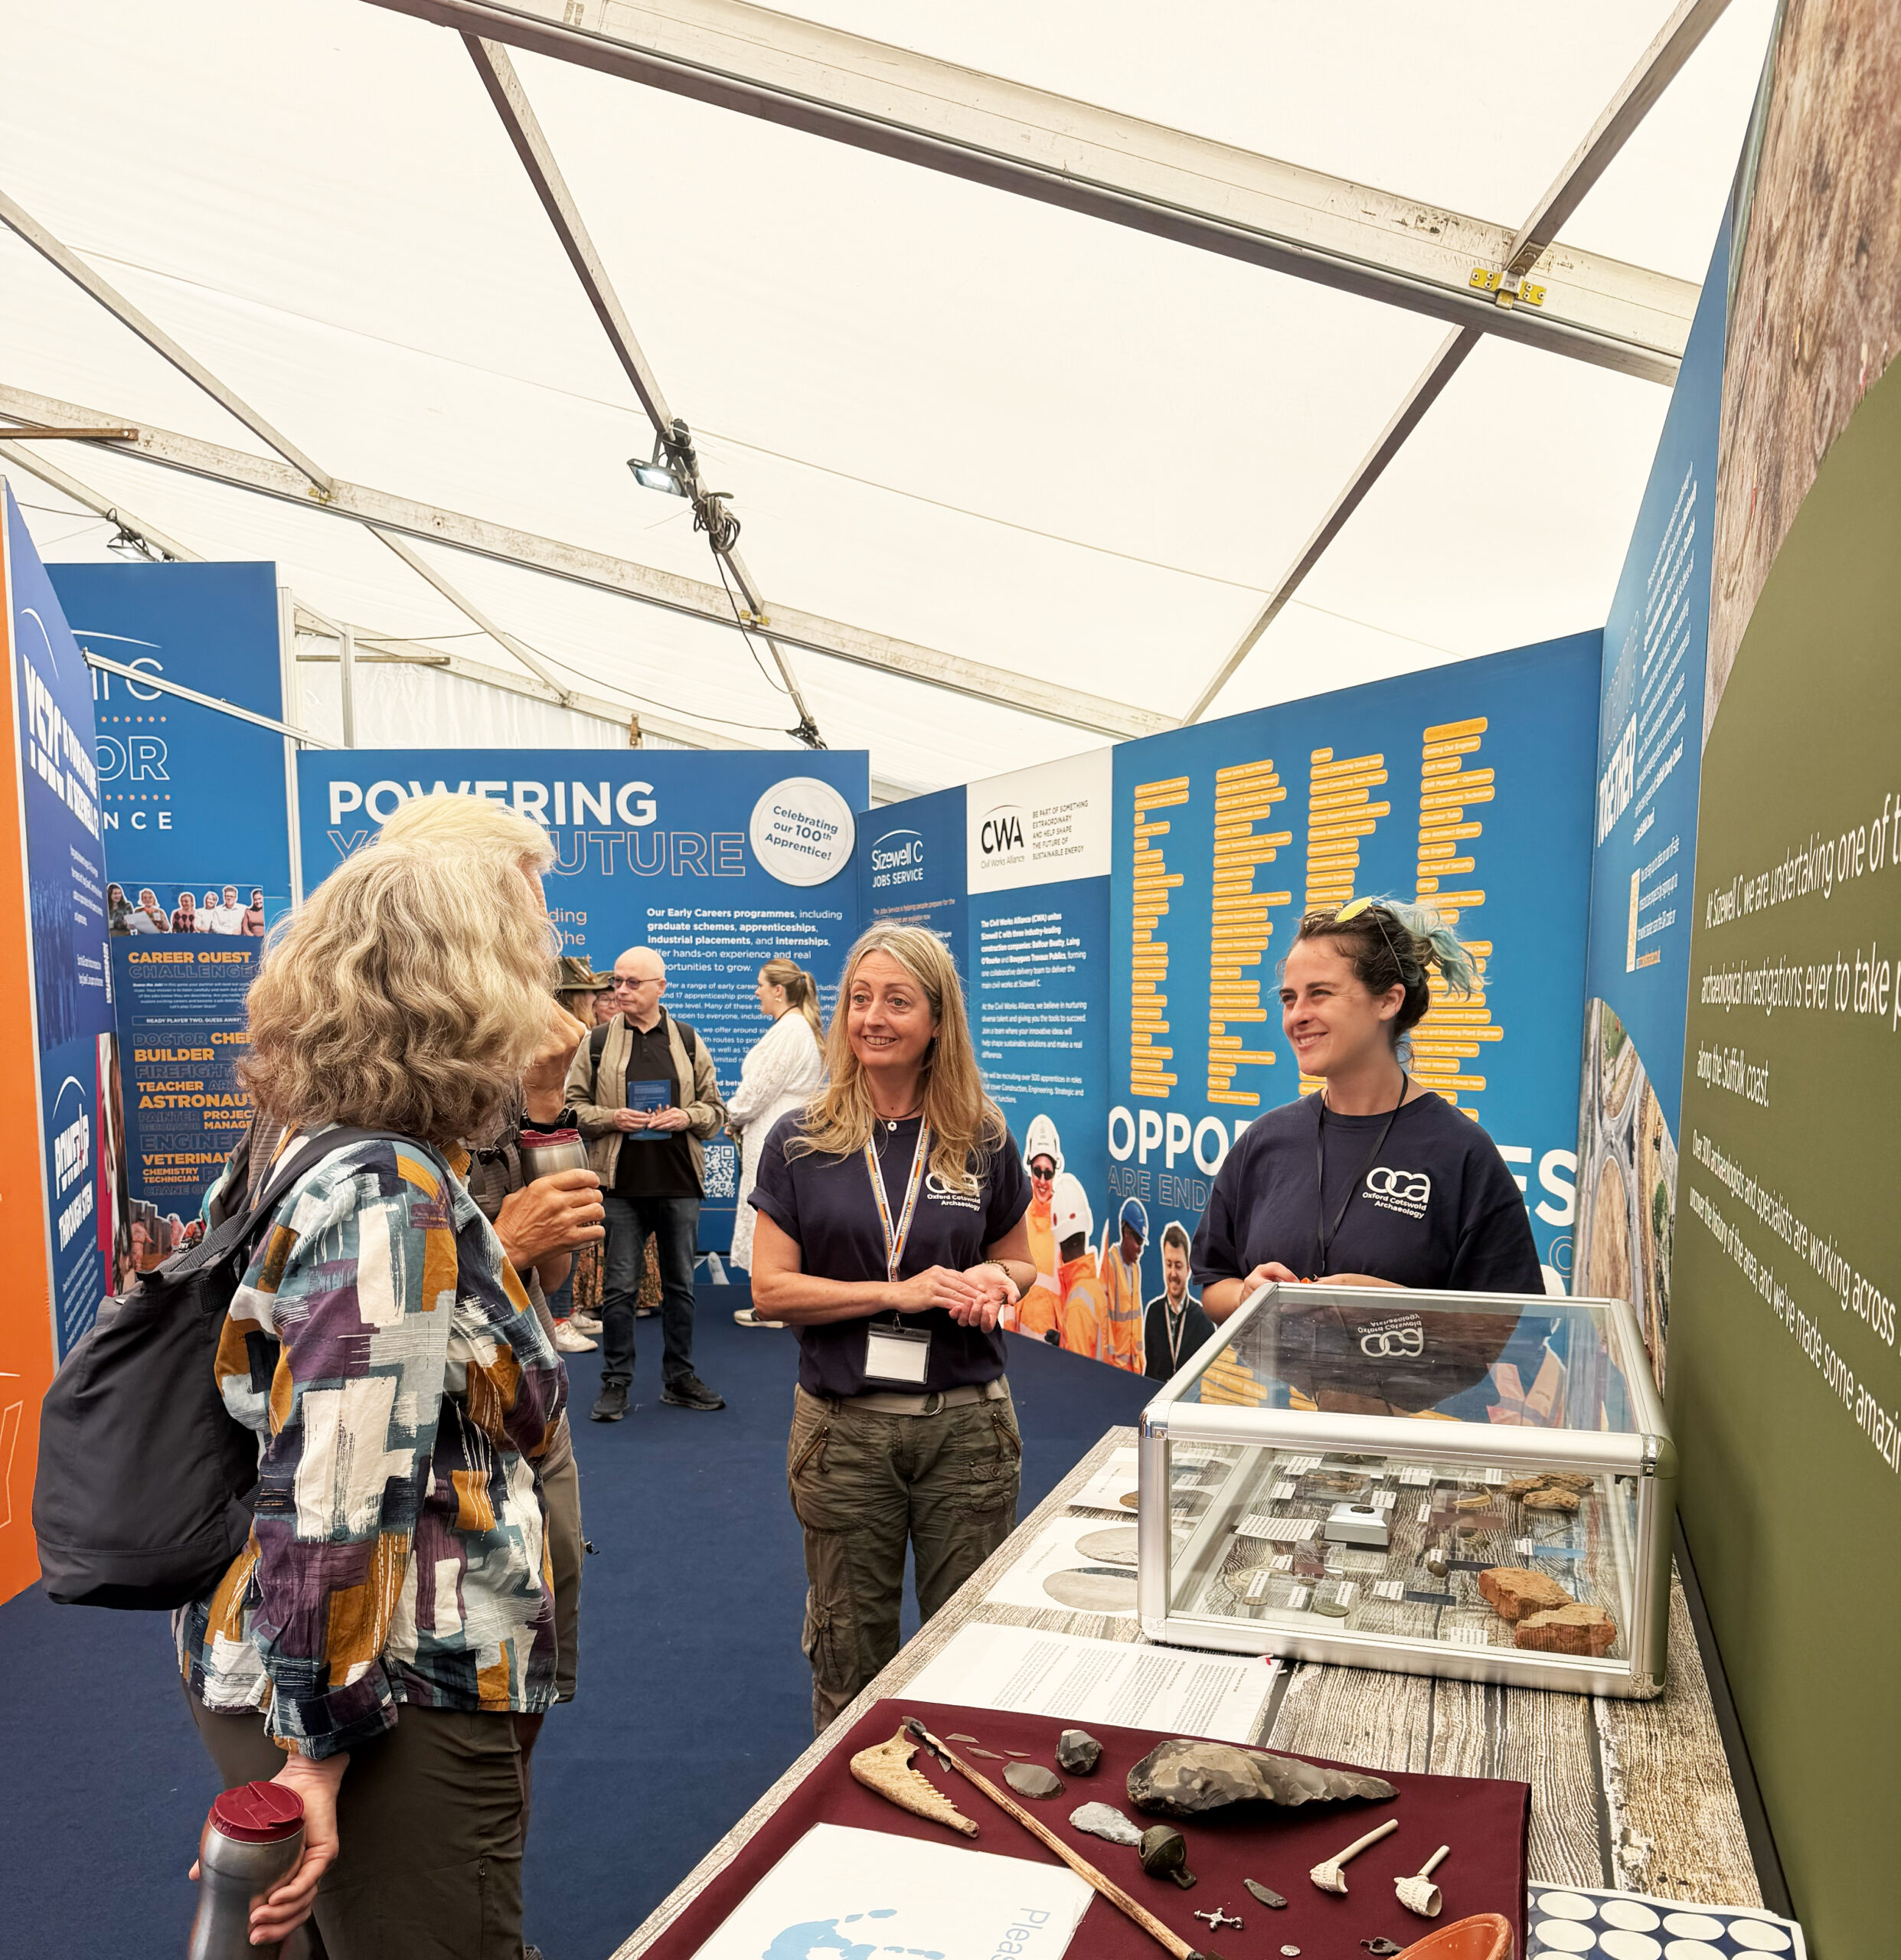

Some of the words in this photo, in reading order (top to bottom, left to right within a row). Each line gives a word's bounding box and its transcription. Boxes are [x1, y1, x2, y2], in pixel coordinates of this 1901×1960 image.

[1040, 808, 1051, 816] PART
[1052, 806, 1059, 815] OF
[1060, 800, 1089, 812] SOMETHING
[773, 805, 838, 835] Celebrating
[1033, 815, 1073, 829] EXTRAORDINARY
[773, 822, 794, 834] our
[795, 825, 832, 842] 100th
[982, 816, 1024, 854] CWA
[1044, 828, 1056, 838] HELP
[1057, 825, 1073, 835] SHAPE
[765, 833, 832, 861] Apprentice!
[1042, 838, 1060, 848] FUTURE
[1061, 836, 1069, 846] OF
[546, 831, 746, 877] UTURE
[871, 842, 912, 871] Sizewell
[913, 840, 923, 864] C
[1033, 848, 1063, 861] SUSTAINABLE
[1065, 845, 1084, 855] ENERGY
[991, 857, 1006, 867] Works
[1007, 854, 1025, 864] Alliance
[1705, 893, 1713, 929] At
[1712, 876, 1737, 927] Sizewell
[1736, 874, 1744, 918] C
[1744, 878, 1754, 915] we
[1755, 871, 1769, 911] are
[1770, 831, 1835, 906] undertaking
[1837, 825, 1866, 883] one
[1870, 792, 1891, 872] of
[872, 874, 890, 888] JOBS
[892, 867, 924, 885] SERVICE
[646, 908, 665, 918] Our
[668, 908, 692, 920] Early
[694, 909, 732, 919] Careers
[733, 909, 797, 921] programmes,
[799, 910, 843, 922] including
[647, 923, 691, 933] graduate
[693, 923, 737, 933] schemes,
[740, 923, 818, 934] apprenticeships,
[647, 935, 693, 945] industrial
[695, 936, 753, 946] placements,
[755, 936, 773, 946] and
[776, 936, 831, 948] internships,
[128, 952, 194, 964] CAREER
[198, 952, 252, 964] QUEST
[673, 949, 717, 959] hands-on
[720, 949, 772, 960] experience
[773, 950, 792, 959] and
[794, 950, 812, 959] real
[663, 962, 712, 973] portunities
[714, 963, 724, 972] to
[727, 964, 753, 974] grow.
[1701, 959, 1743, 1013] archaeological
[1743, 953, 1803, 1017] investigations
[1805, 964, 1833, 1010] ever
[1834, 950, 1850, 1012] to
[1854, 941, 1890, 1015] take
[741, 1013, 772, 1021] including
[133, 1033, 207, 1047] DOCTOR
[134, 1048, 215, 1063] BUILDER
[1697, 1040, 1712, 1089] along
[1712, 1044, 1722, 1086] the
[1722, 1047, 1746, 1096] Suffolk
[1746, 1060, 1769, 1109] coast.
[136, 1081, 204, 1093] TEACHER
[138, 1112, 201, 1123] PAINTER
[204, 1120, 252, 1130] MANAGE
[140, 1132, 243, 1152] ENGINEE
[142, 1152, 230, 1166] VETERINAR
[142, 1168, 198, 1176] CHEMISTRY
[143, 1185, 190, 1196] CRANE
[941, 1200, 980, 1211] Archaeology
[952, 1194, 980, 1204] Cotswold
[1362, 1191, 1389, 1202] Oxford
[1390, 1197, 1427, 1211] Cotswold
[1374, 1200, 1425, 1220] Archaeology
[1692, 1129, 1703, 1160] Over
[1702, 1135, 1712, 1168] 300
[1710, 1145, 1745, 1198] archaeologists
[1744, 1174, 1757, 1210] and
[1756, 1187, 1793, 1246] specialists
[1793, 1219, 1808, 1260] are
[1809, 1232, 1850, 1312] working
[1852, 1272, 1896, 1348] across
[1689, 1186, 1706, 1220] uncover
[1704, 1195, 1713, 1230] the
[1712, 1202, 1729, 1254] history
[1727, 1223, 1735, 1256] of
[1734, 1228, 1743, 1268] the
[1743, 1246, 1758, 1293] area,
[1759, 1264, 1773, 1305] and
[1773, 1282, 1795, 1334] we've
[1795, 1315, 1823, 1370] made
[1823, 1341, 1854, 1411] some
